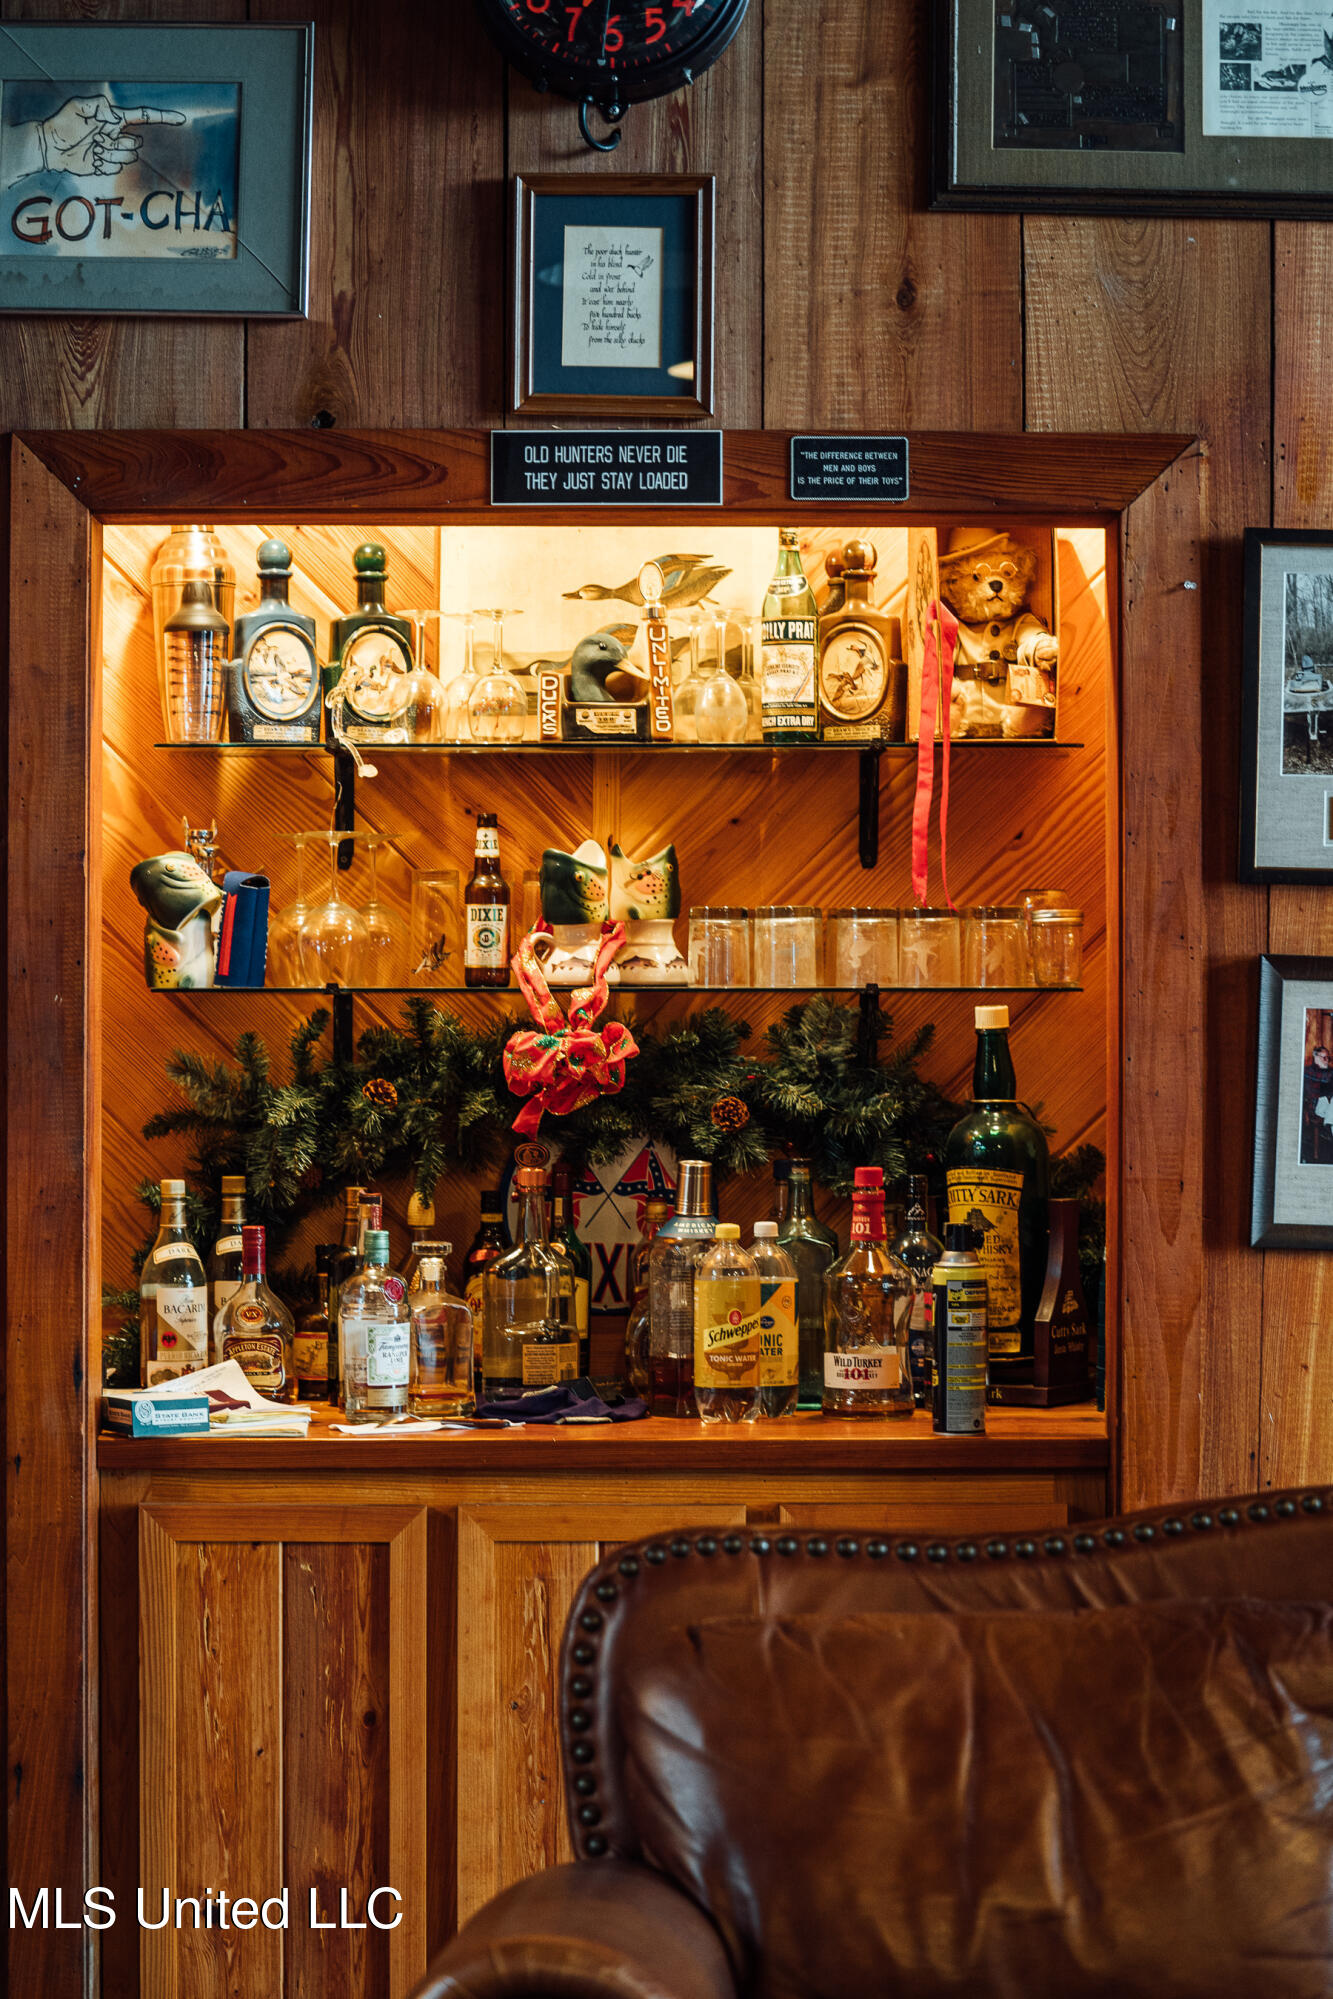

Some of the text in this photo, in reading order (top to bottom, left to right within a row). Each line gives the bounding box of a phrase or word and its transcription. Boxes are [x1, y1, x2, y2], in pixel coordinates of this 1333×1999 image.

[566, 7, 582, 42] 7
[645, 8, 666, 45] 5
[604, 15, 624, 52] 6
[11, 189, 233, 244] GOT-CHA
[524, 446, 688, 463] OLD HUNTERS NEVER DIE
[820, 452, 863, 460] DIFFERENCE
[864, 452, 898, 460] BETWEEN
[823, 464, 877, 472] MEN AND BOYS
[524, 472, 688, 490] THEY JUST STAY LOADED
[797, 477, 805, 485] IS
[807, 477, 821, 485] THE
[823, 477, 844, 485] PRICE
[846, 477, 856, 485] OF
[859, 477, 879, 485] THEIR
[649, 627, 672, 732] UNLIMITED
[541, 676, 558, 735] DUCKS
[777, 716, 801, 727] EXTRA
[801, 716, 815, 727] DRY
[475, 839, 499, 850] DIXIE
[471, 908, 504, 922] DIXIE
[980, 1189, 1017, 1207] SARK
[982, 1244, 1014, 1254] HISKY
[1051, 1321, 1087, 1339] Cutty Sark
[228, 1343, 277, 1356] APPLETON ESTATE
[760, 1347, 784, 1356] ATER
[709, 1355, 733, 1363] TONIC
[834, 1355, 882, 1368] WILD TURKEY
[844, 1368, 870, 1380] 101
